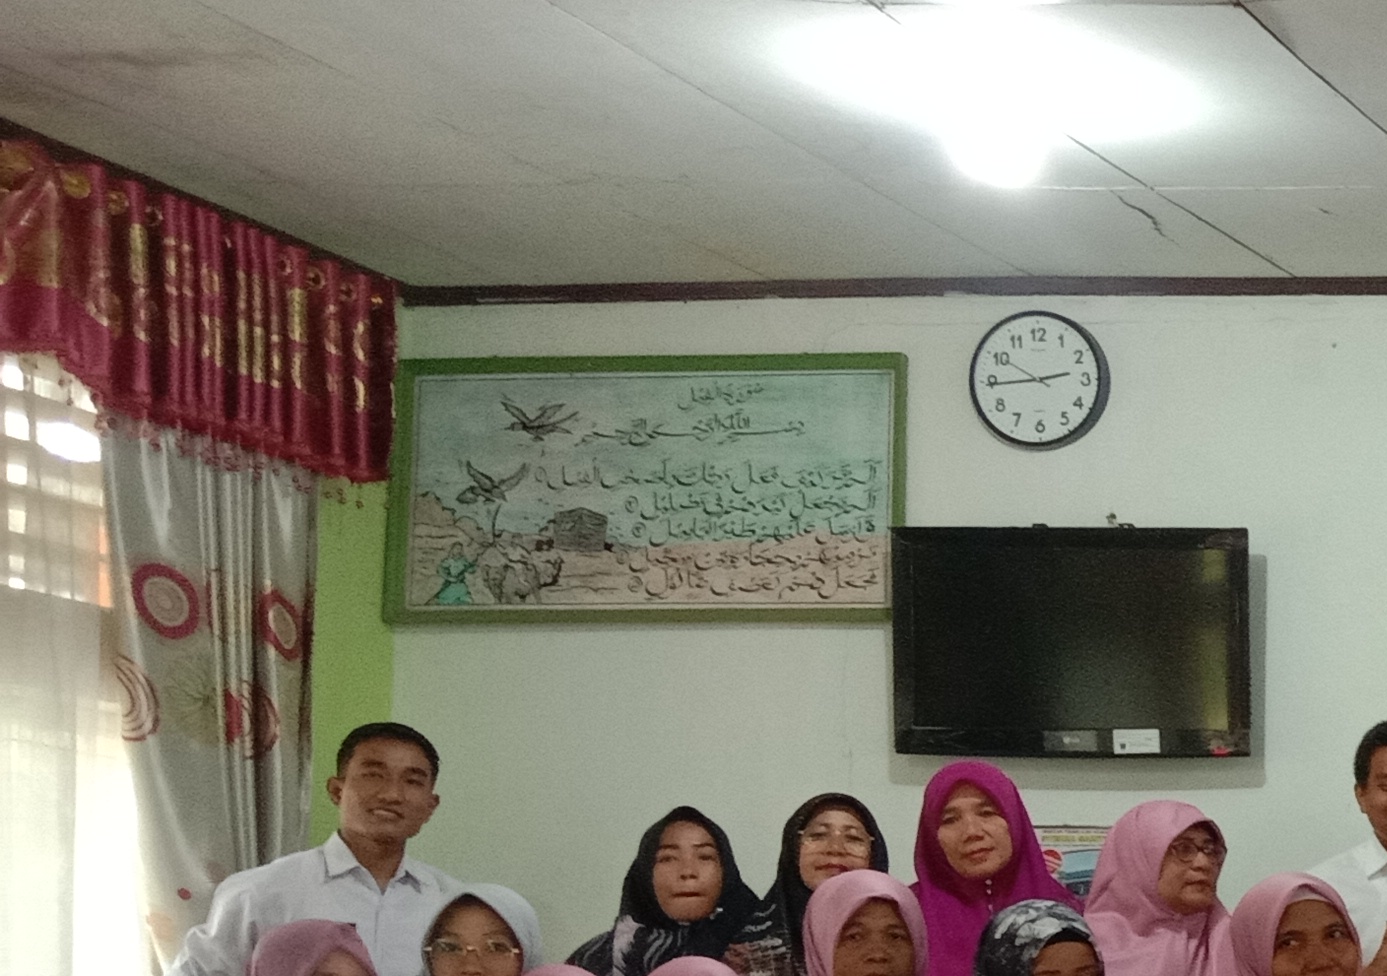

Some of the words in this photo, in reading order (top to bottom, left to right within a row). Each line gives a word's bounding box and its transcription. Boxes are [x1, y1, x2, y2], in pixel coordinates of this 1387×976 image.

[1010, 335, 1022, 348] 11
[1030, 328, 1046, 342] 12
[1058, 334, 1064, 348] 1
[993, 352, 1009, 366] 10
[1074, 350, 1084, 364] 2
[1081, 372, 1090, 386] 3
[996, 398, 1005, 412] 8
[1073, 396, 1084, 410] 4
[1012, 413, 1021, 427] 7
[1060, 412, 1069, 425] 5
[1035, 420, 1045, 433] 6
